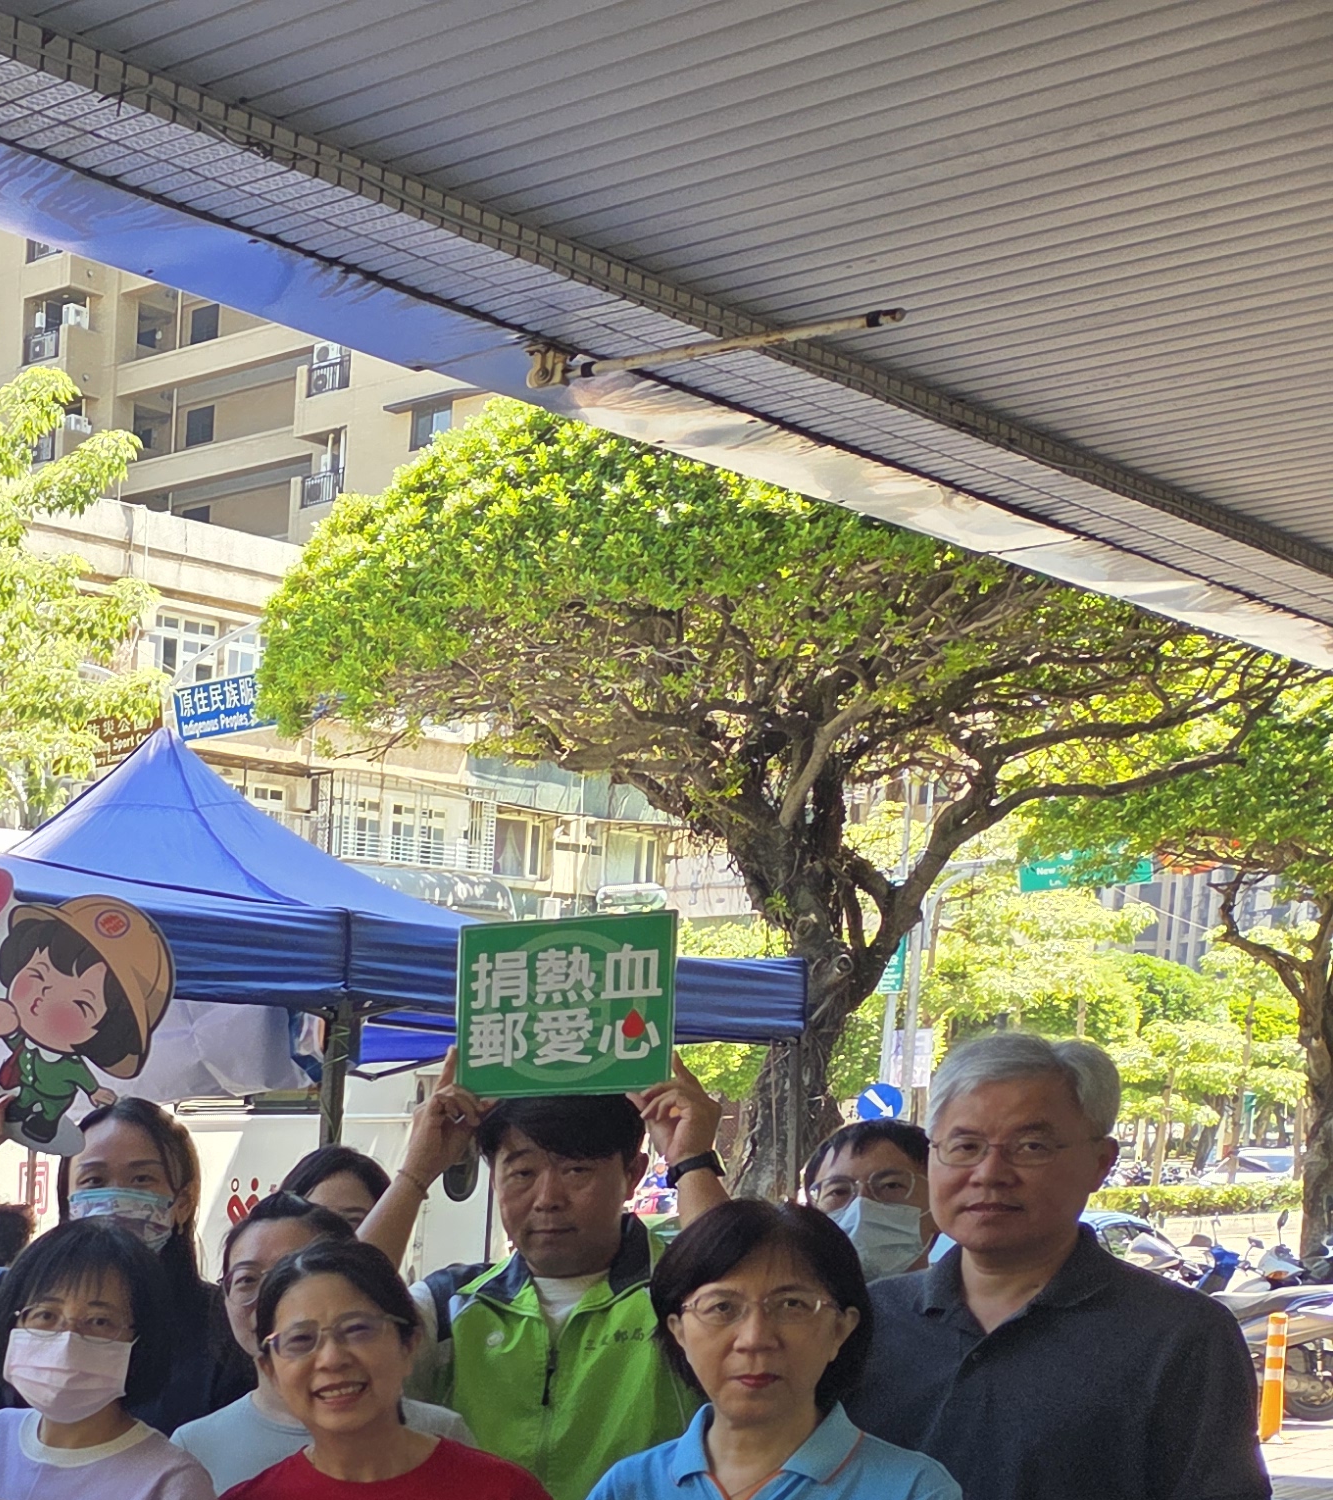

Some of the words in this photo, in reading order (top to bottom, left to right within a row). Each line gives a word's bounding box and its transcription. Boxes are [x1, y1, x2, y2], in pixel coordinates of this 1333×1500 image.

[179, 677, 262, 717] 原住民族服
[182, 717, 218, 738] Indigenous
[470, 942, 662, 1011] 捐熱血
[467, 1009, 660, 1069] 郵愛心
